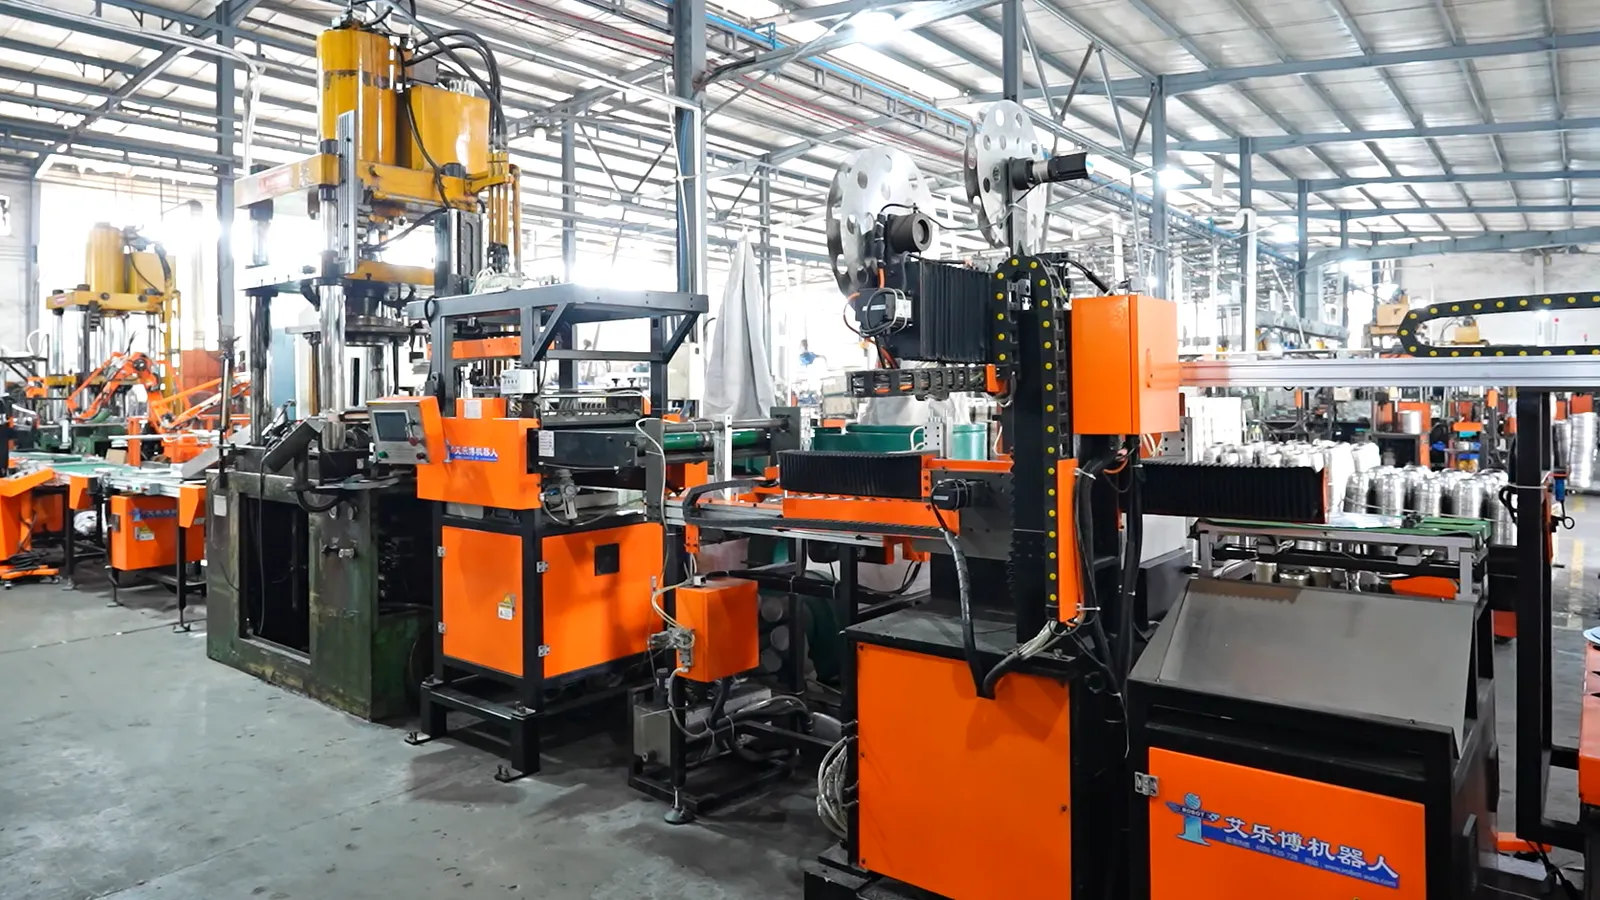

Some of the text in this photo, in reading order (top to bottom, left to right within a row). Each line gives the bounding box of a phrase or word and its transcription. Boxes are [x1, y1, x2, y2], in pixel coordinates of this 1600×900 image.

[1223, 817, 1399, 879] 艾乐博机器人
